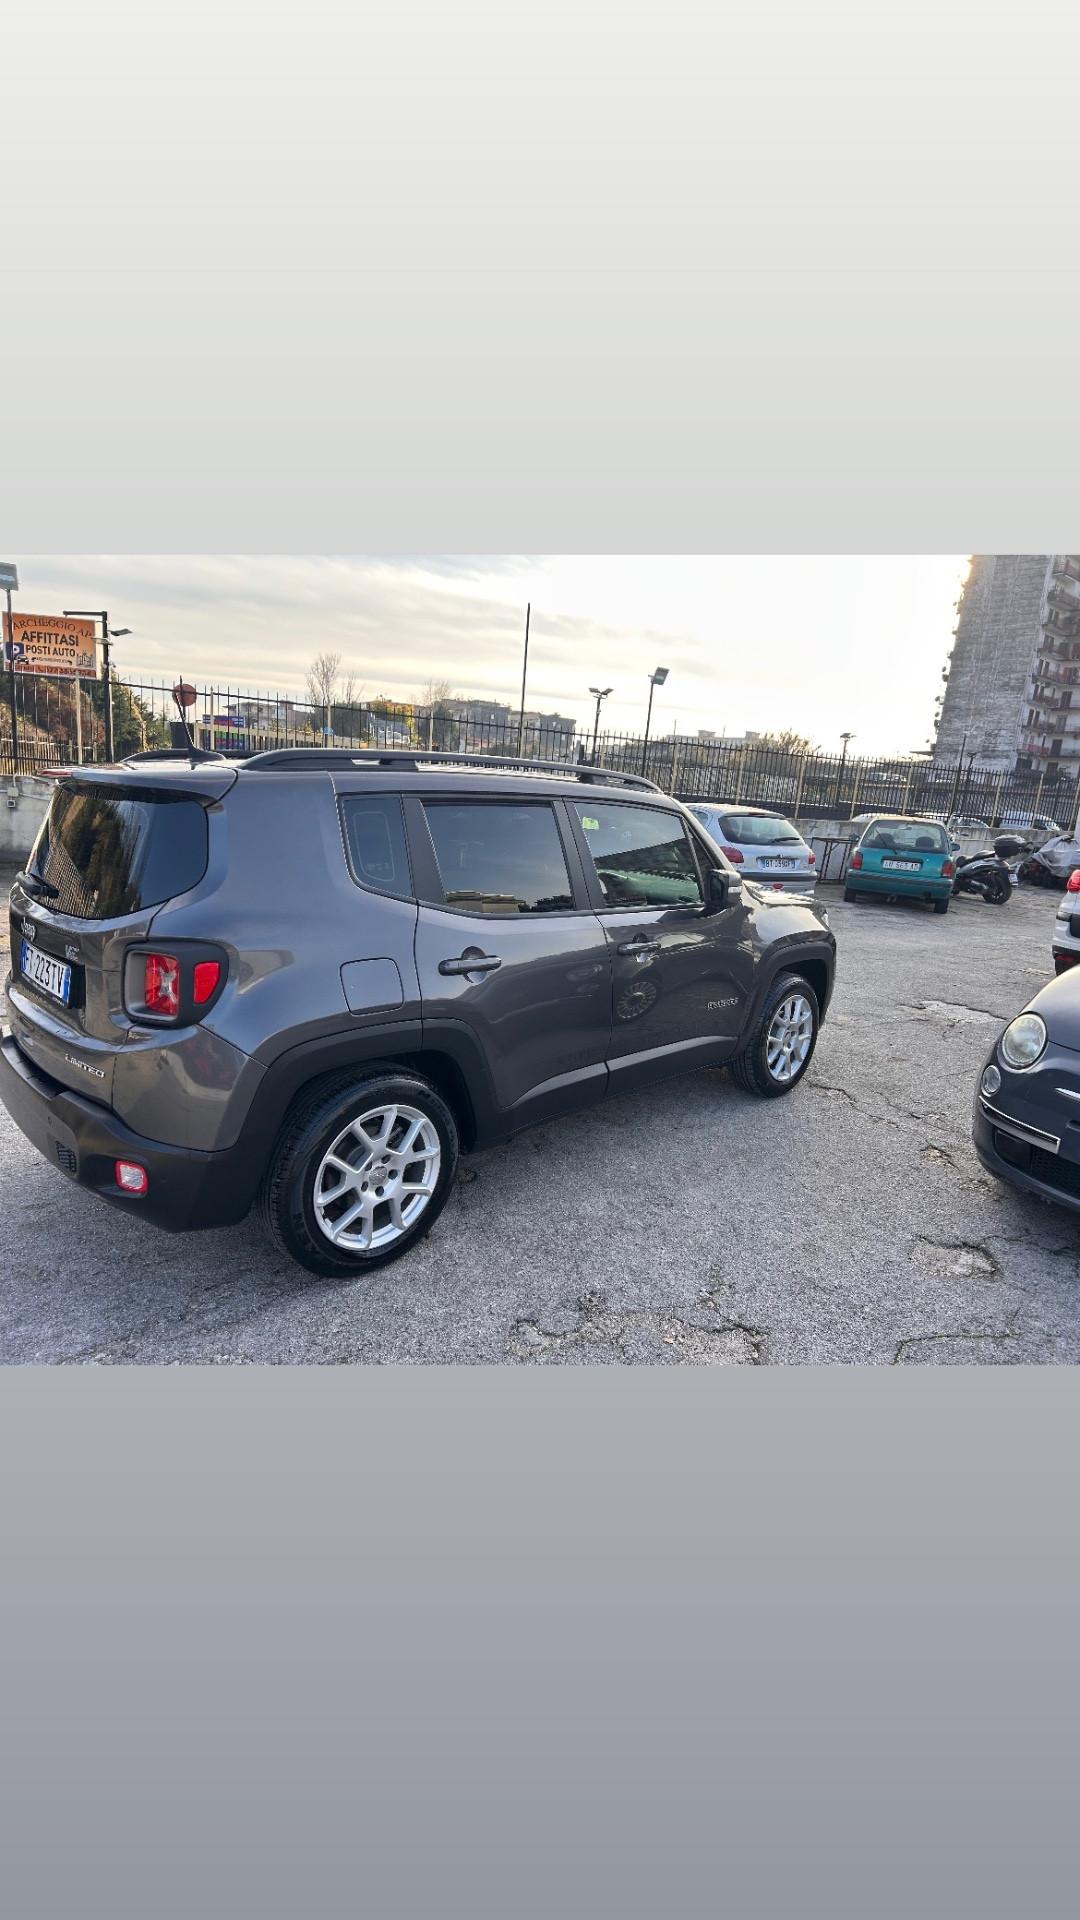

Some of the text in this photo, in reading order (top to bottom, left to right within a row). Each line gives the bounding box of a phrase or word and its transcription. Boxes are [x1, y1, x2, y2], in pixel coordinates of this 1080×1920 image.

[21, 630, 79, 647] AFFITTASI
[25, 644, 76, 658] POSTI AUTO
[35, 954, 65, 994] 223TV
[65, 1053, 105, 1078] LIMITED
